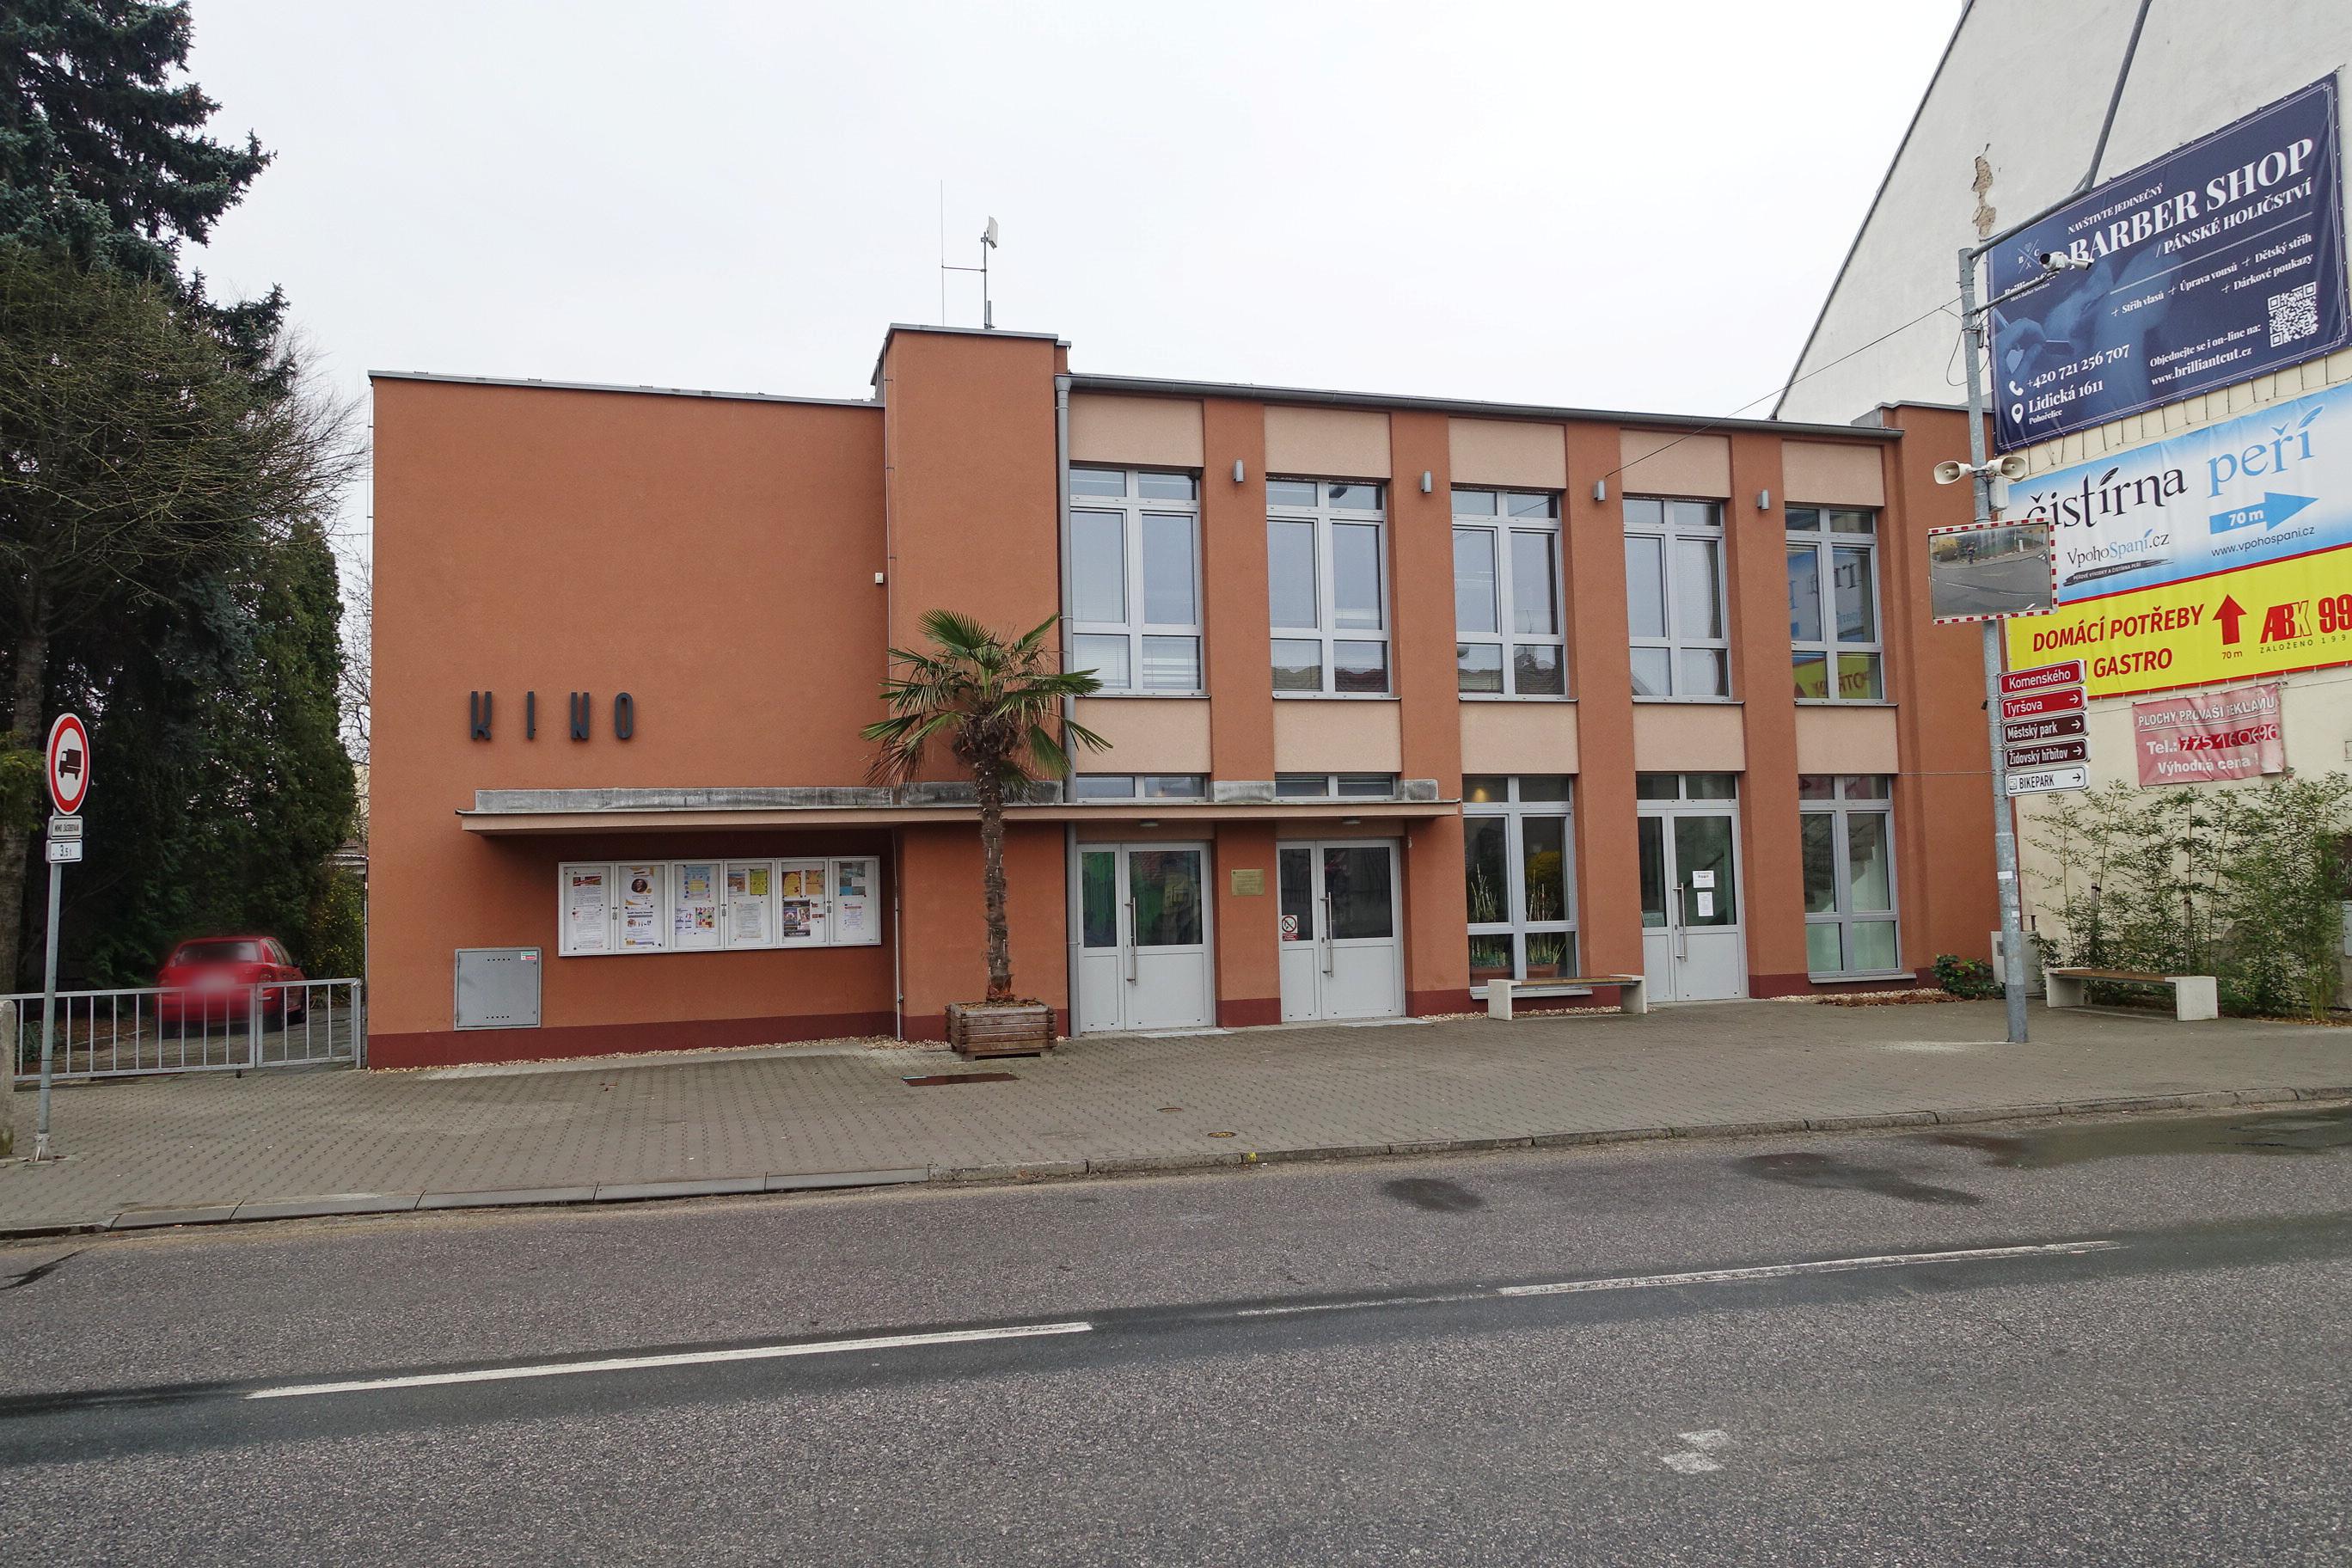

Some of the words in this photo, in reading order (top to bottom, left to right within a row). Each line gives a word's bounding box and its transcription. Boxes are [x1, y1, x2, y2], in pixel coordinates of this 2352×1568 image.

[2067, 207, 2114, 234] NAVŠTIVTE
[2114, 182, 2164, 215] JEDINEČNÝ
[2069, 191, 2199, 270] BARBER
[2206, 138, 2313, 211] SHOP
[2164, 217, 2220, 255] PÁNSKÉ
[2223, 177, 2312, 230] HOLIČSTVÍ
[2122, 299, 2142, 314] Střih
[2142, 291, 2164, 306] vlasů
[2179, 274, 2210, 291] Úprava
[2211, 262, 2238, 280] vousů
[2255, 242, 2288, 263] Dětský
[2288, 233, 2312, 249] střih
[2233, 268, 2271, 291] Dárkové
[2273, 254, 2313, 276] poukazy
[2150, 346, 2195, 368] Objednejte
[2196, 342, 2206, 352] se
[2212, 328, 2245, 346] on-line
[2246, 323, 2262, 336] na:
[2026, 371, 2056, 389] +420
[2059, 363, 2078, 380] 721
[2080, 351, 2104, 371] 256
[2106, 344, 2130, 364] 707
[2151, 346, 2252, 386] www.brilliantcut.cz
[2028, 384, 2076, 413] Lidická
[2079, 380, 2104, 397] 1611
[2029, 408, 2063, 425] Pohořelice
[2207, 406, 2324, 499] peří
[2228, 511, 2246, 526] 70
[2248, 509, 2263, 521] m
[2067, 529, 2170, 567] VpohoSpaní.cz
[2211, 526, 2315, 557] www.vpohospani.cz
[2033, 616, 2105, 652] DOMÁCÍ
[2110, 603, 2205, 640] POTŘEBY
[2318, 594, 2352, 634] 99
[2093, 647, 2173, 678] GASTRO
[2260, 640, 2313, 653] ZALOŽENO
[2009, 669, 2071, 689] Komenského
[470, 691, 634, 740] KINO
[2006, 700, 2043, 717] Tyršova
[2138, 711, 2177, 726] PLOCHY
[2198, 704, 2224, 720] VAŠI
[2007, 723, 2038, 739] Městský
[2040, 721, 2058, 738] park
[2009, 750, 2040, 765] Židovský
[2041, 749, 2068, 762] hřbitov
[2147, 741, 2179, 755] Tel.:
[2018, 774, 2055, 790] BIKEPARK
